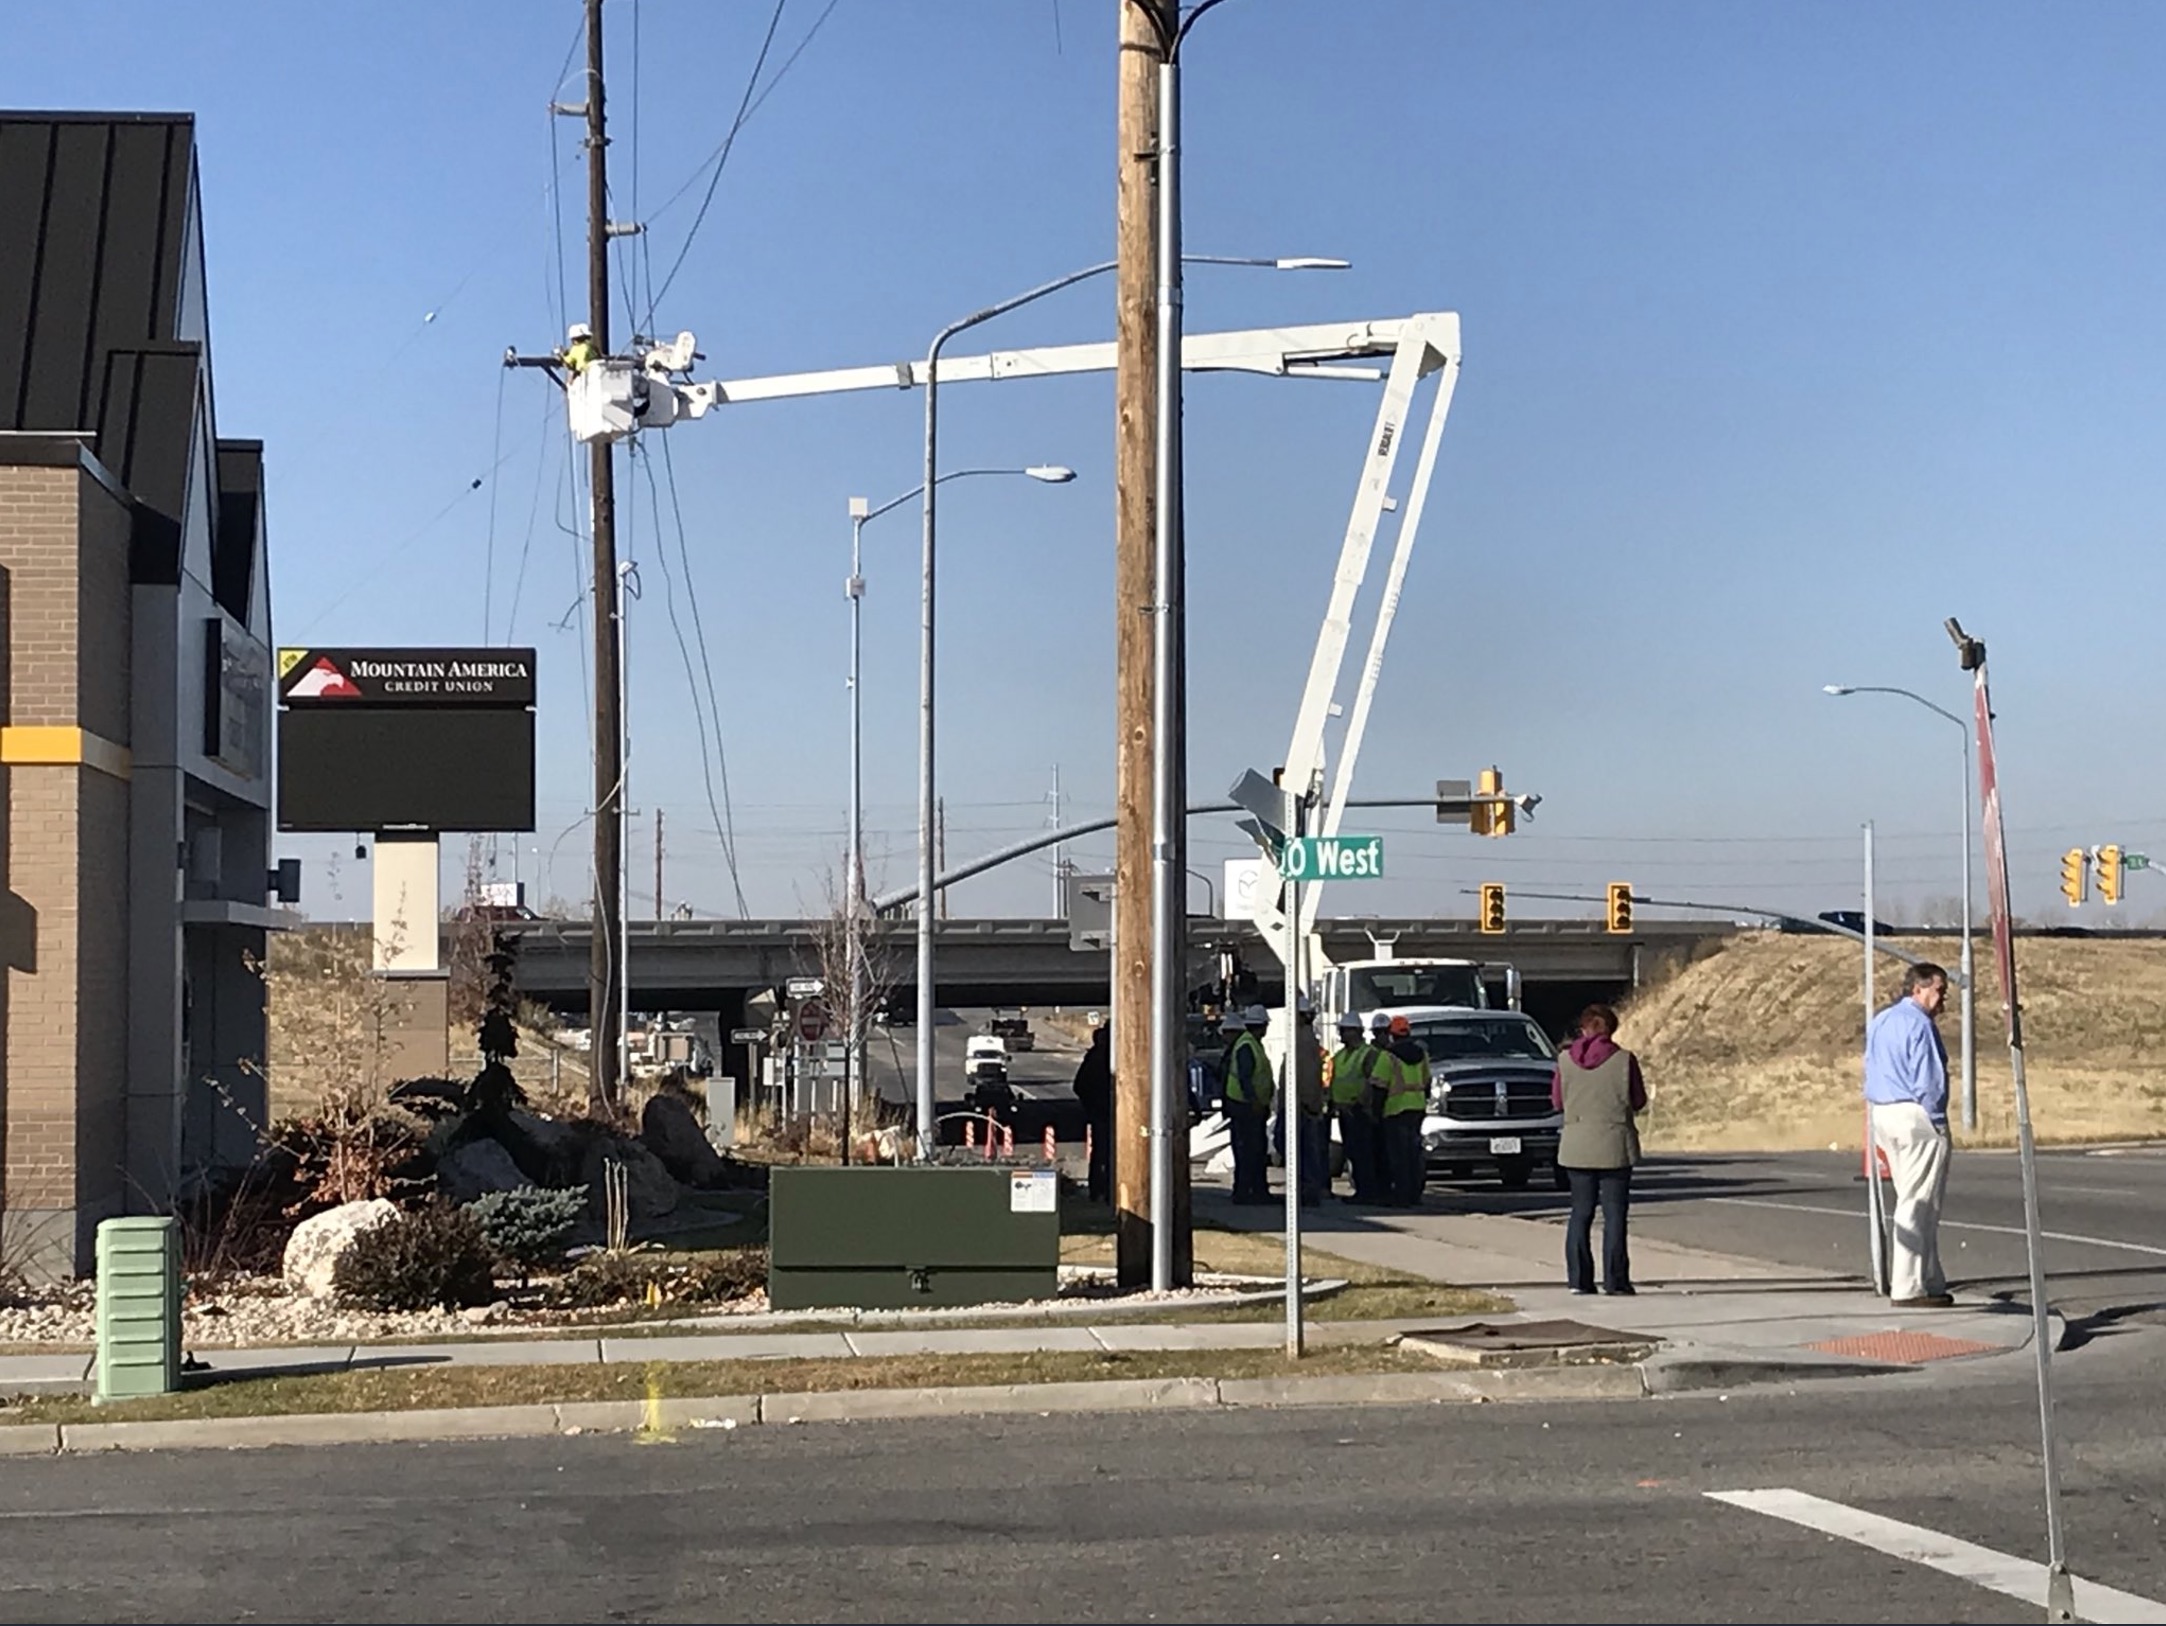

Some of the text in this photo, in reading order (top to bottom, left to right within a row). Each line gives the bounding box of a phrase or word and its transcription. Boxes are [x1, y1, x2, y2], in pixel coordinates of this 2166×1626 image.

[350, 661, 528, 678] MOUNTAIN AMERICA
[384, 681, 493, 692] CREDIT UNION
[1316, 840, 1380, 876] West
